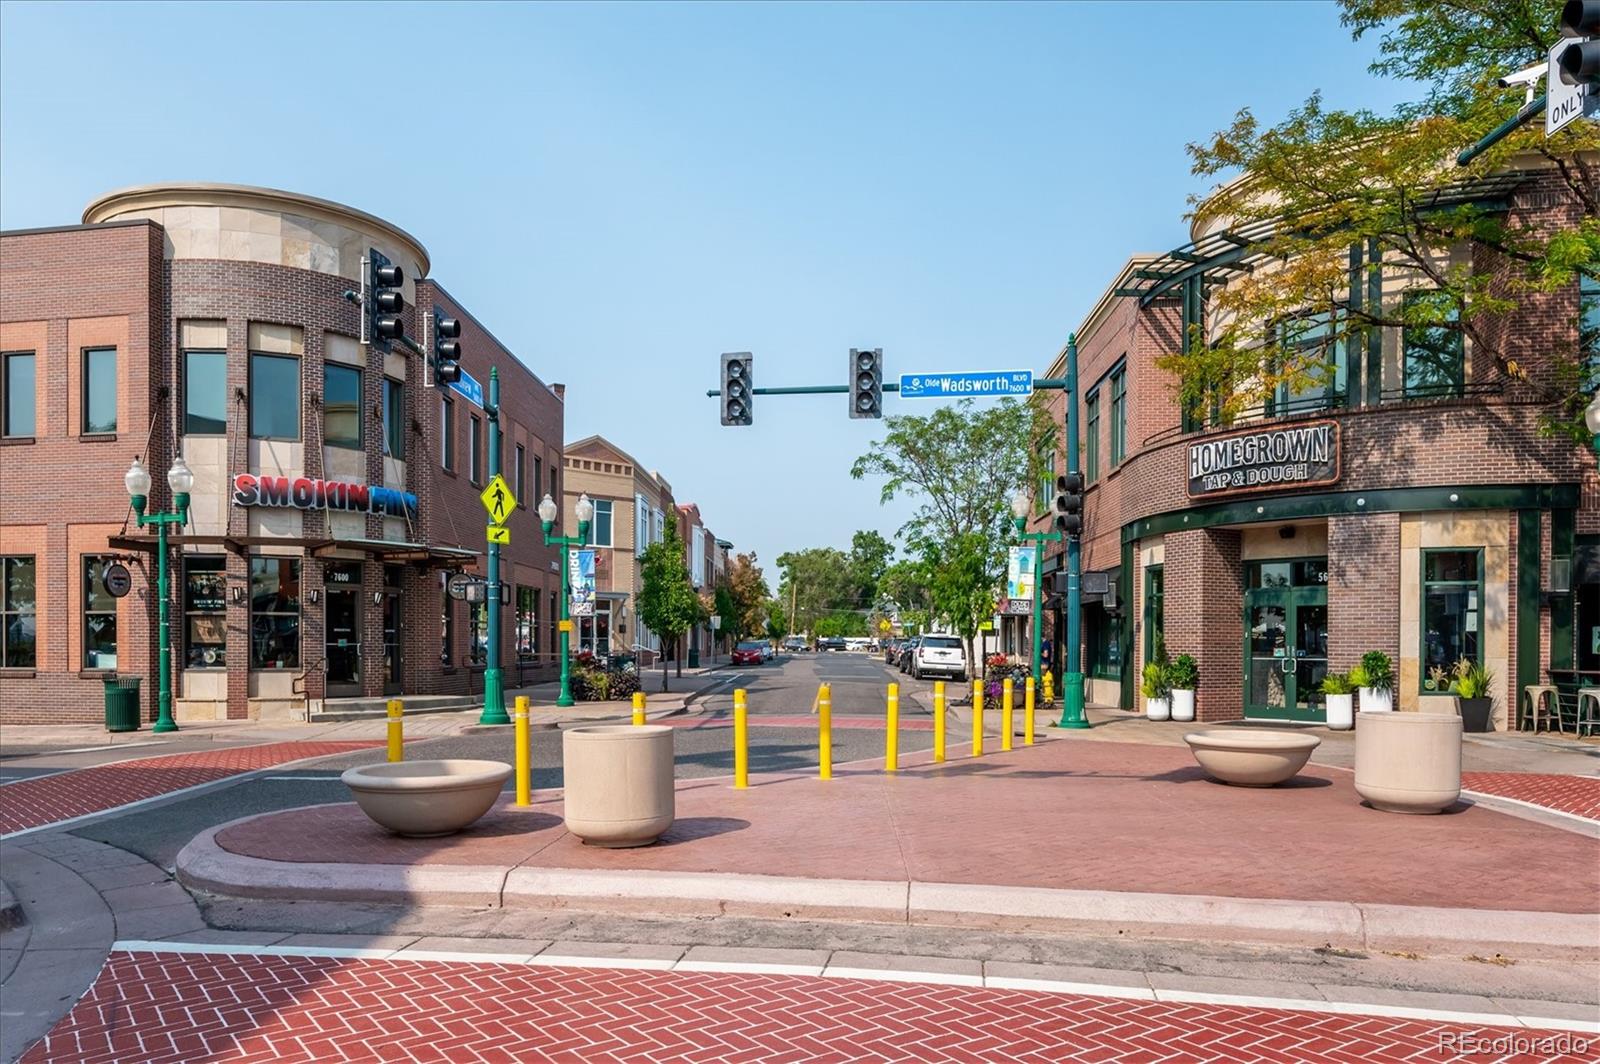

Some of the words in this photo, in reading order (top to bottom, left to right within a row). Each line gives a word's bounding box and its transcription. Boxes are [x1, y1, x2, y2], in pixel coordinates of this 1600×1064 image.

[1552, 91, 1584, 124] ONLY
[924, 378, 940, 388] Olde
[940, 376, 1009, 393] Wadsworth
[1009, 384, 1025, 393] 7600
[1012, 374, 1028, 382] BLVD
[1189, 426, 1329, 480] HOMEGROWN
[1202, 473, 1232, 491] TAP
[1232, 470, 1246, 487] &
[1246, 463, 1309, 486] DOUGH
[232, 473, 369, 514] SMOKIN
[334, 573, 350, 582] 7600
